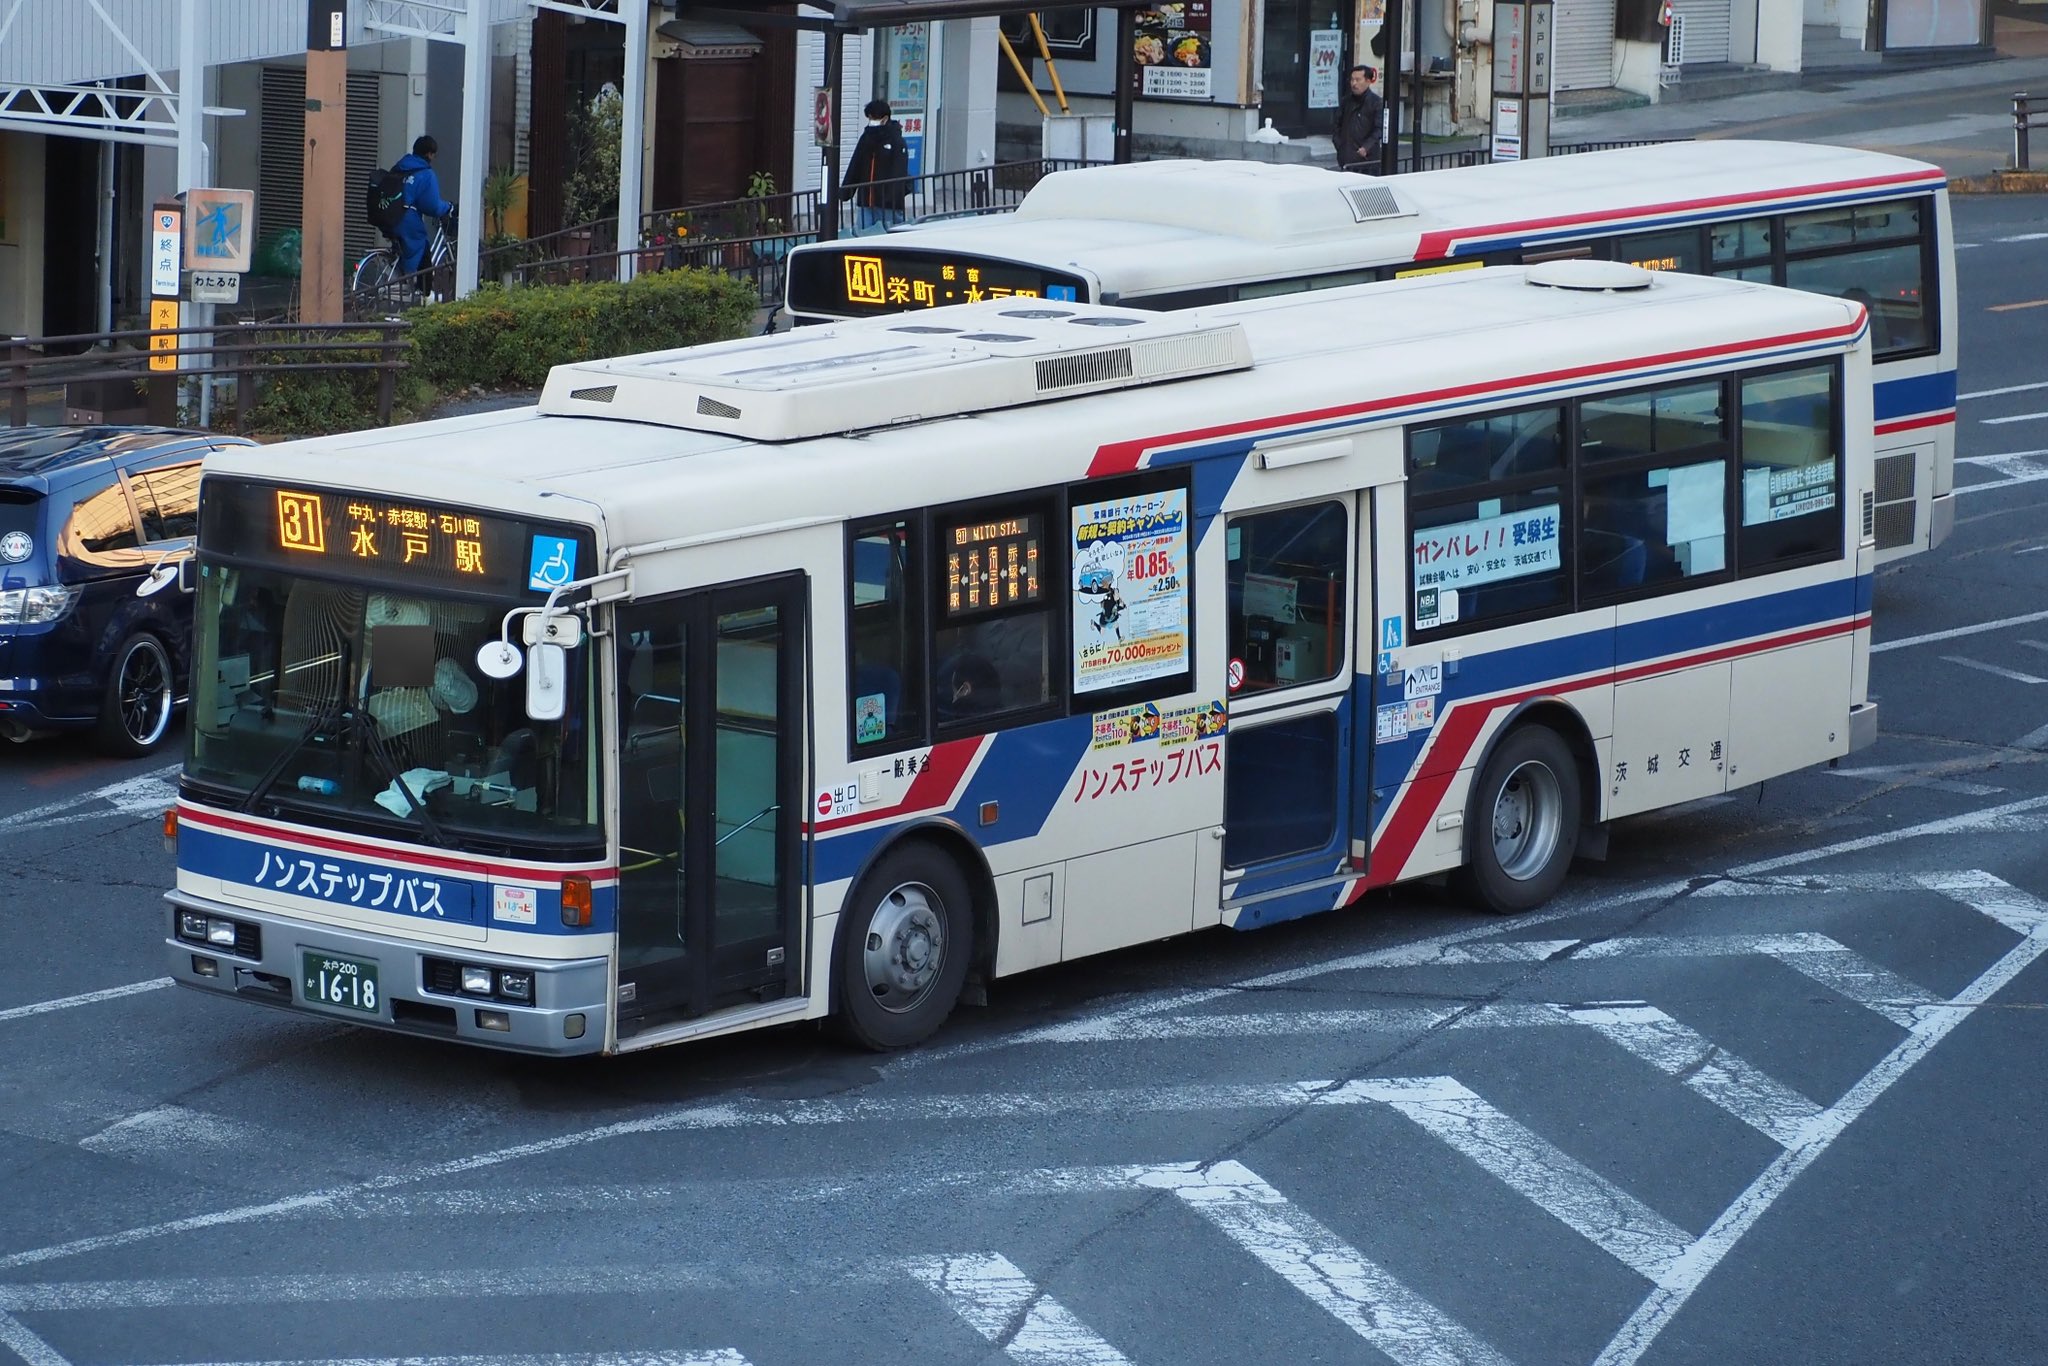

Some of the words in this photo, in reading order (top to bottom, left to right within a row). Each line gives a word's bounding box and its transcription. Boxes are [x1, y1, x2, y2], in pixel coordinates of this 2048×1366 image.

[1536, 11, 1545, 87] 水戸駅前
[160, 239, 172, 271] 終点
[194, 276, 237, 288] わたるな
[851, 262, 880, 297] 40
[942, 266, 979, 282] 飯富
[1123, 500, 1165, 514] マイカーローン
[283, 499, 316, 545] 31
[973, 525, 996, 541] MITO
[1000, 521, 1021, 537] STA.
[1078, 510, 1182, 541] 新規ご契約キャンペーン
[1513, 516, 1556, 547] 受験生
[350, 524, 484, 574] 水戸駅
[1026, 548, 1038, 592] 中丸
[1419, 568, 1459, 586] 試験会場へは
[1467, 558, 1507, 577] 安心・安全な
[1420, 594, 1435, 608] NBA
[1415, 682, 1441, 695] ENTRANCE
[1419, 666, 1438, 683] 入口
[881, 754, 931, 779] 一般乗合
[1074, 743, 1221, 803] ノンステップバス
[1615, 740, 1721, 782] 茨城交通
[834, 784, 857, 804] 出口
[836, 803, 854, 815] EXIT
[255, 851, 444, 916] ノンステップバス
[322, 959, 358, 976] 水戸200
[319, 970, 376, 1009] 16-18
